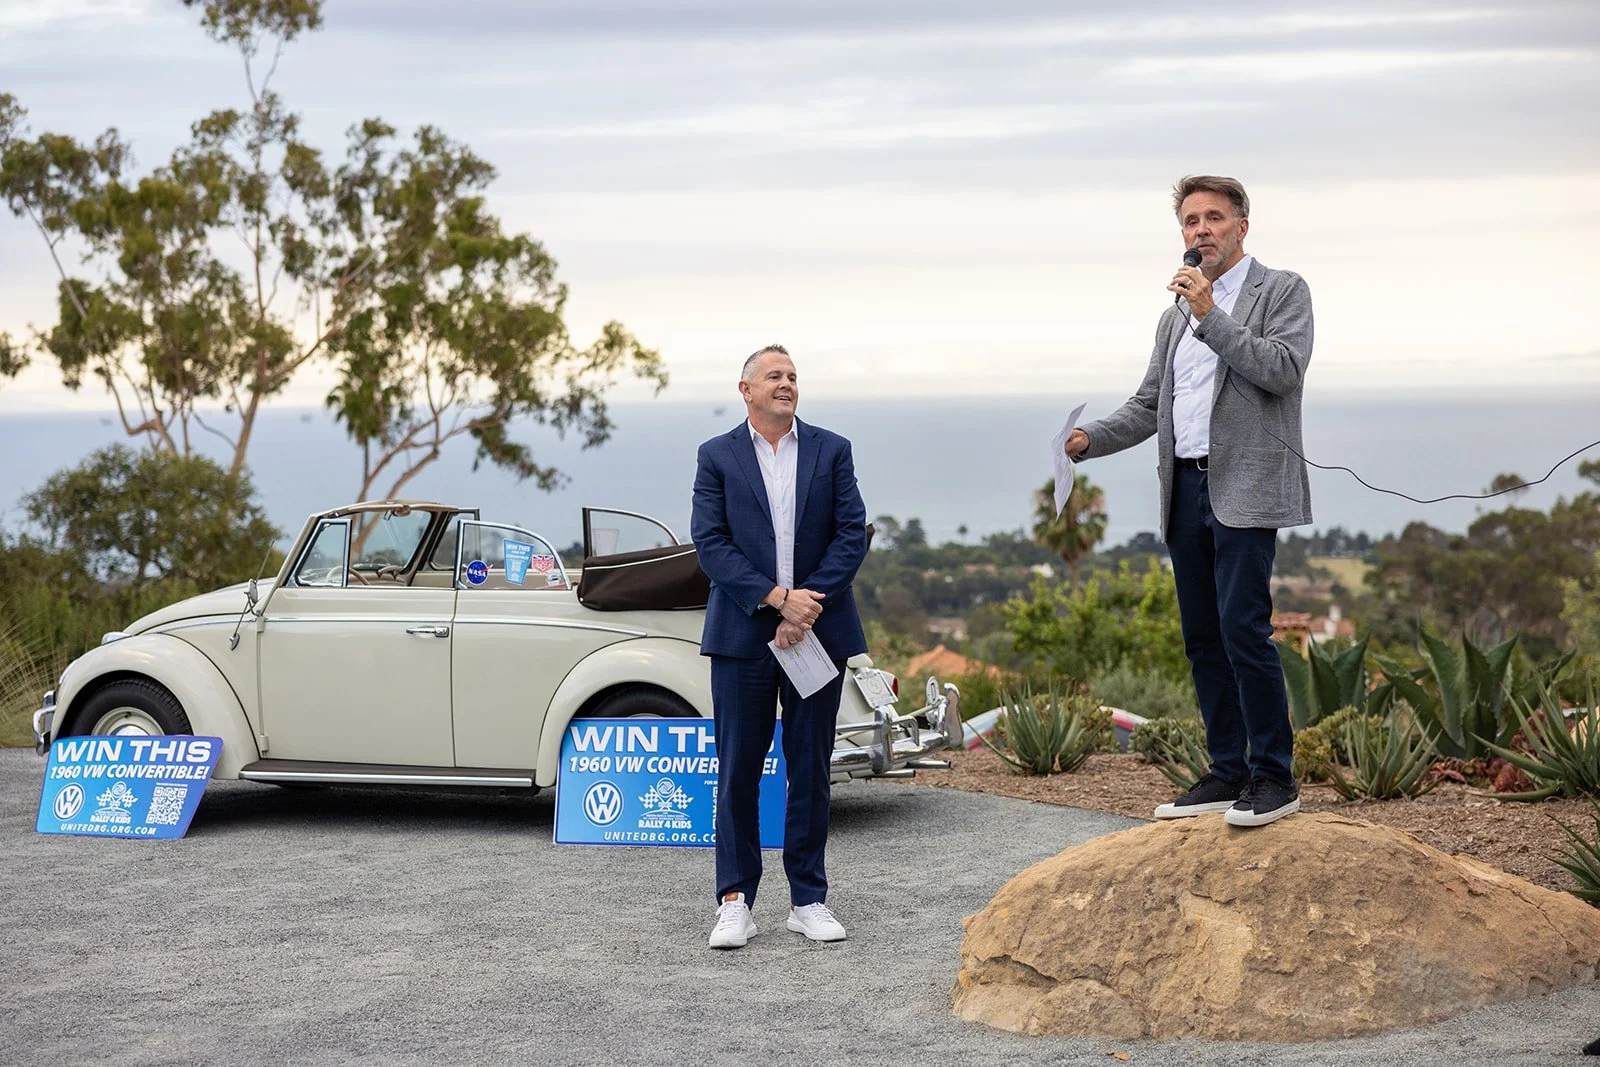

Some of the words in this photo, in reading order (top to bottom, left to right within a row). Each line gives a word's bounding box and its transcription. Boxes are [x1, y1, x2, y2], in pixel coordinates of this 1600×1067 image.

[468, 568, 486, 578] NASA
[570, 726, 659, 753] WIN
[57, 740, 122, 763] WIN
[130, 740, 212, 763] THIS
[569, 756, 611, 773] 1960
[615, 756, 645, 773] VW
[647, 757, 778, 774] CONVERE!
[50, 765, 82, 780] 1960
[83, 765, 106, 779] VW
[107, 765, 209, 780] CONVERTIBLE!
[90, 815, 109, 823] RALLY
[109, 816, 116, 824] 4
[115, 816, 132, 825] KIDS
[638, 820, 663, 829] RALLY
[664, 821, 671, 829] 4
[672, 821, 692, 830] KIDS
[60, 824, 157, 835] UNITEDBG.ORG.COM
[604, 831, 717, 843] UNITEDBG.ORG.CO
